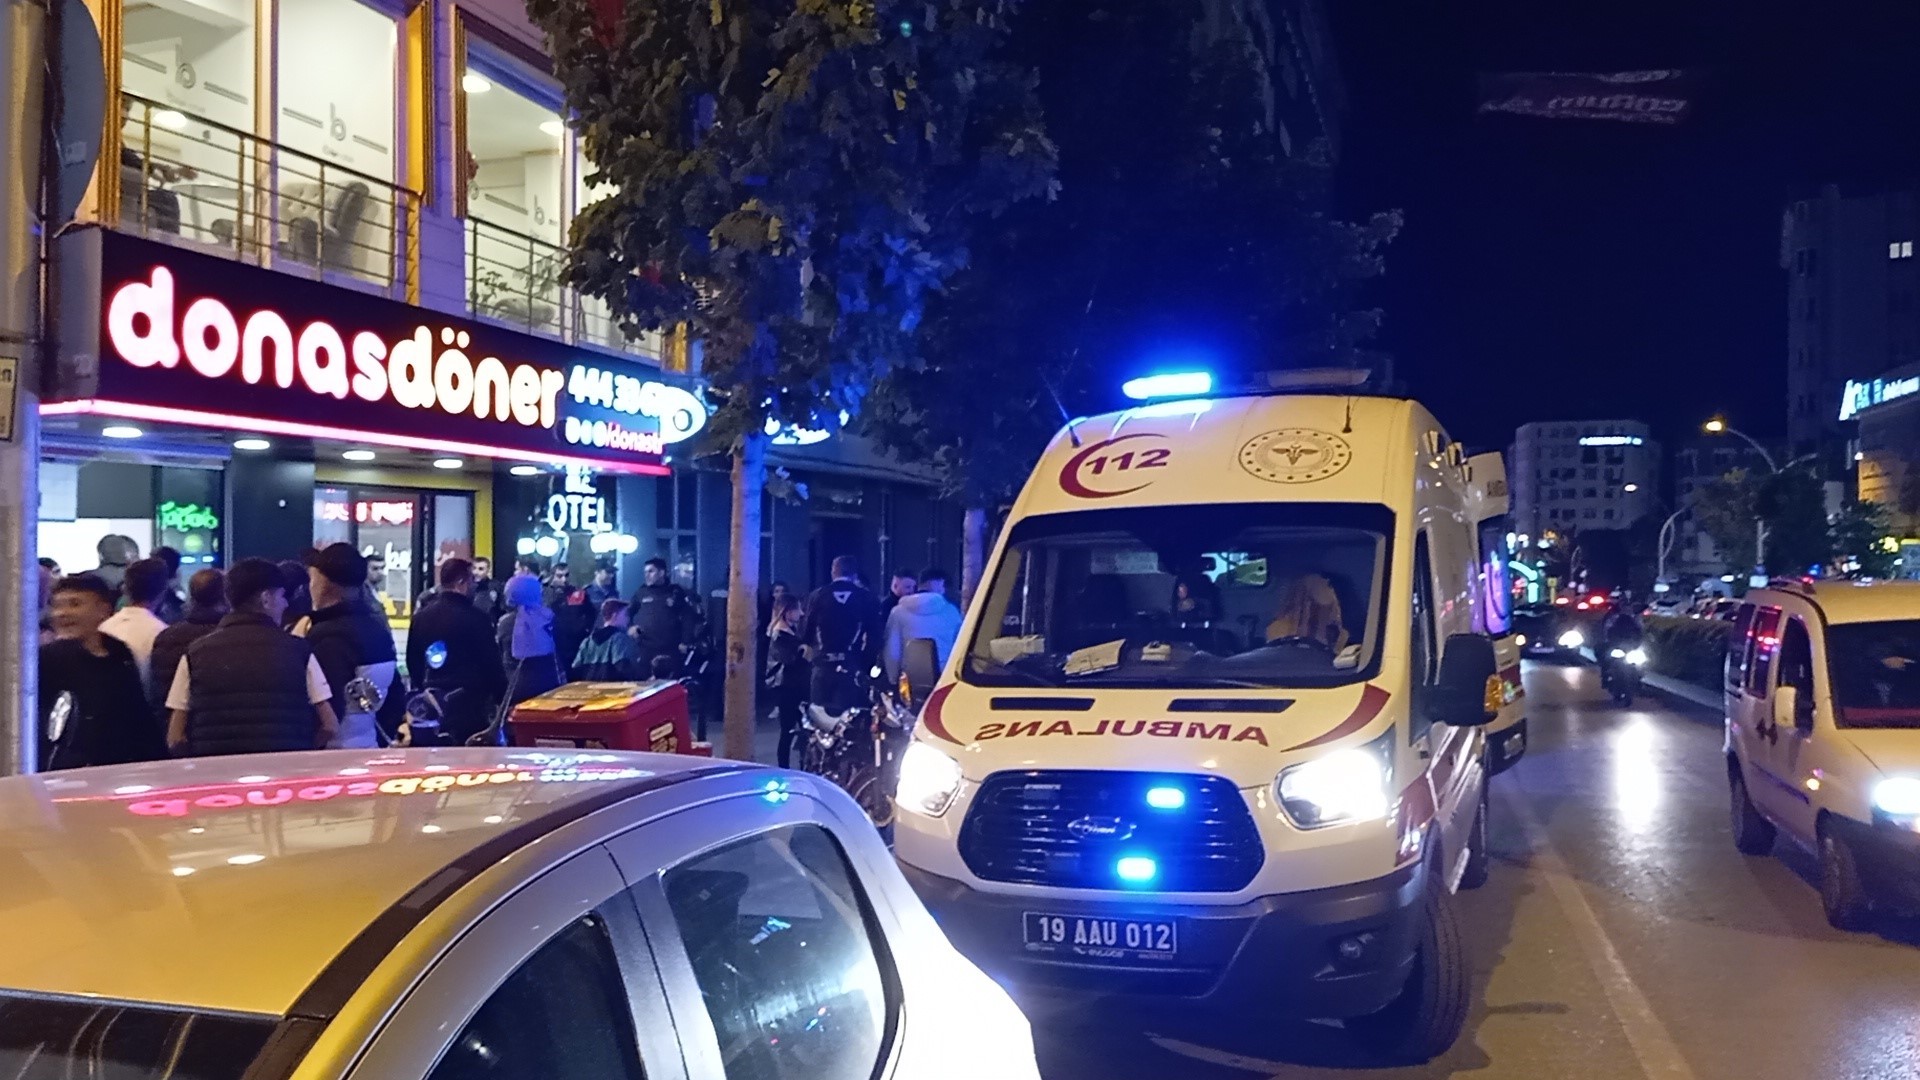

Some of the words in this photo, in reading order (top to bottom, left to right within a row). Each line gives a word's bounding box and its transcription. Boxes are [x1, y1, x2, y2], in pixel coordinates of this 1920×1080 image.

[1085, 448, 1172, 476] 112
[547, 494, 613, 532] OTEL
[1038, 916, 1066, 943] 19
[1073, 919, 1118, 946] AAU
[1125, 923, 1171, 950] 012
